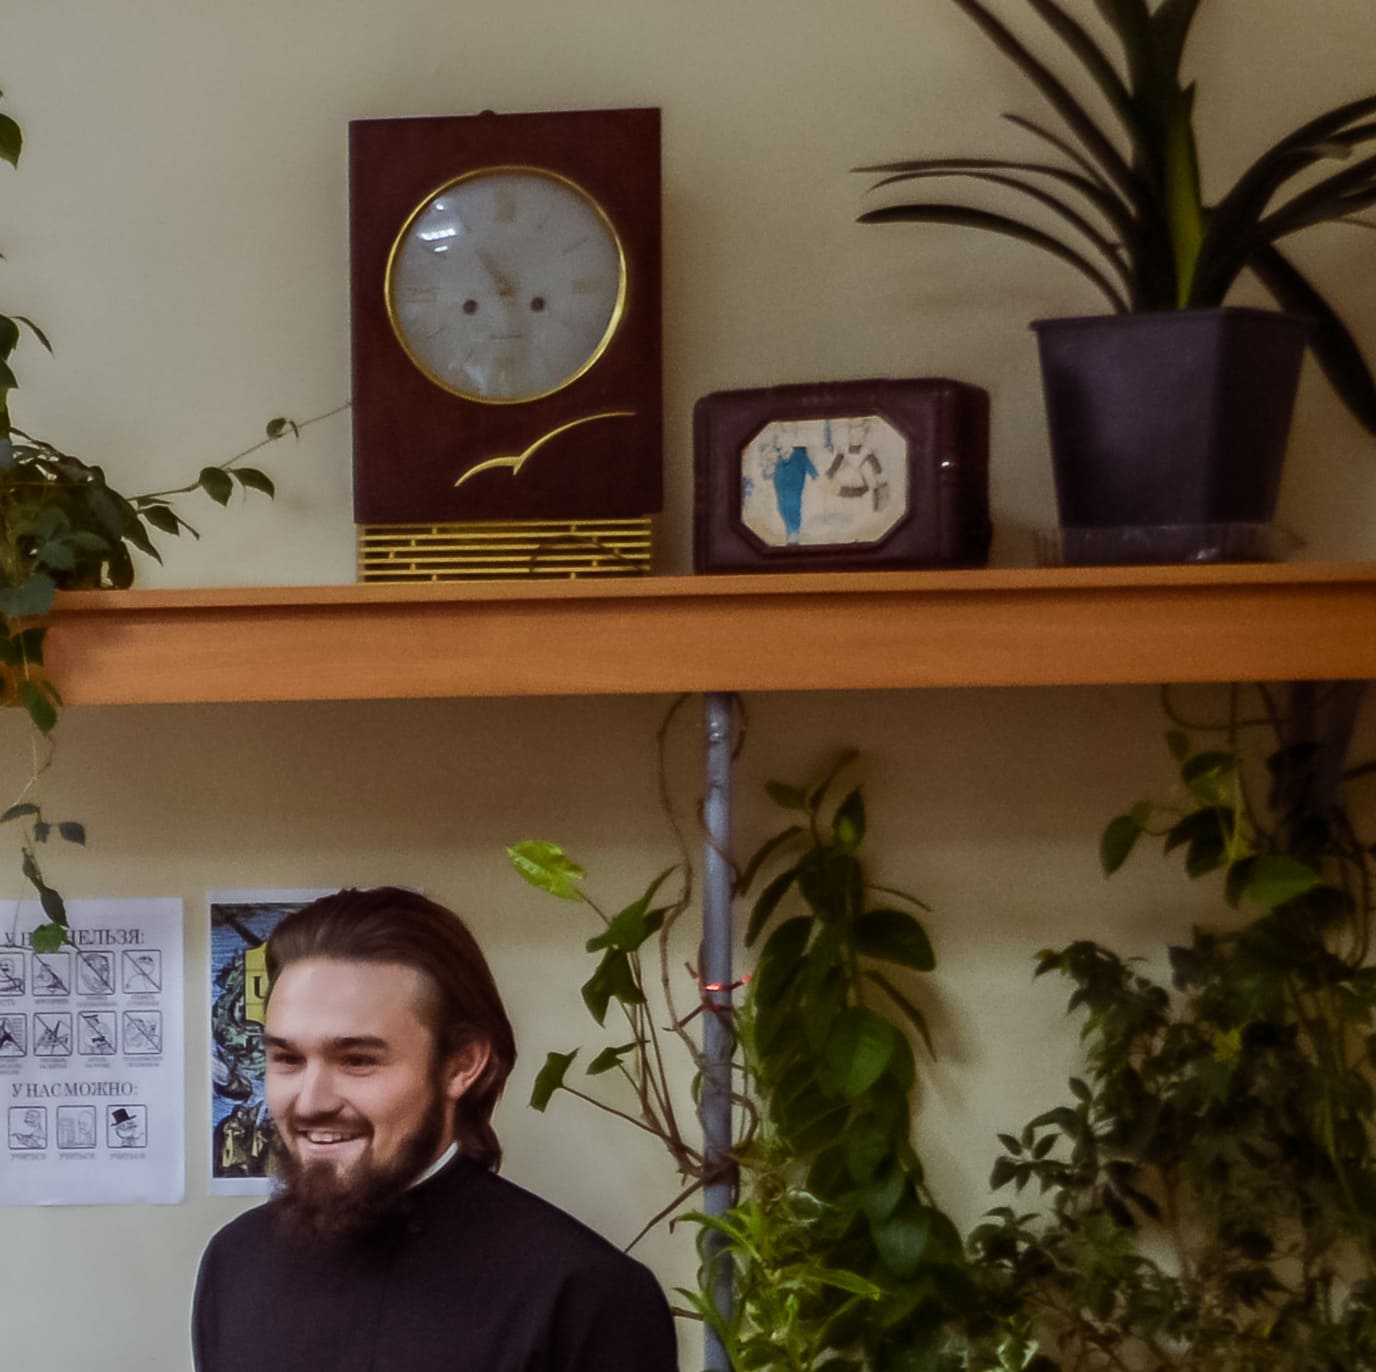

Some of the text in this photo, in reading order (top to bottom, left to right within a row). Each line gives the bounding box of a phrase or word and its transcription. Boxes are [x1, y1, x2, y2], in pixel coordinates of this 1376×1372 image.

[11, 1081, 139, 1098] У НАС МОЖНО:
